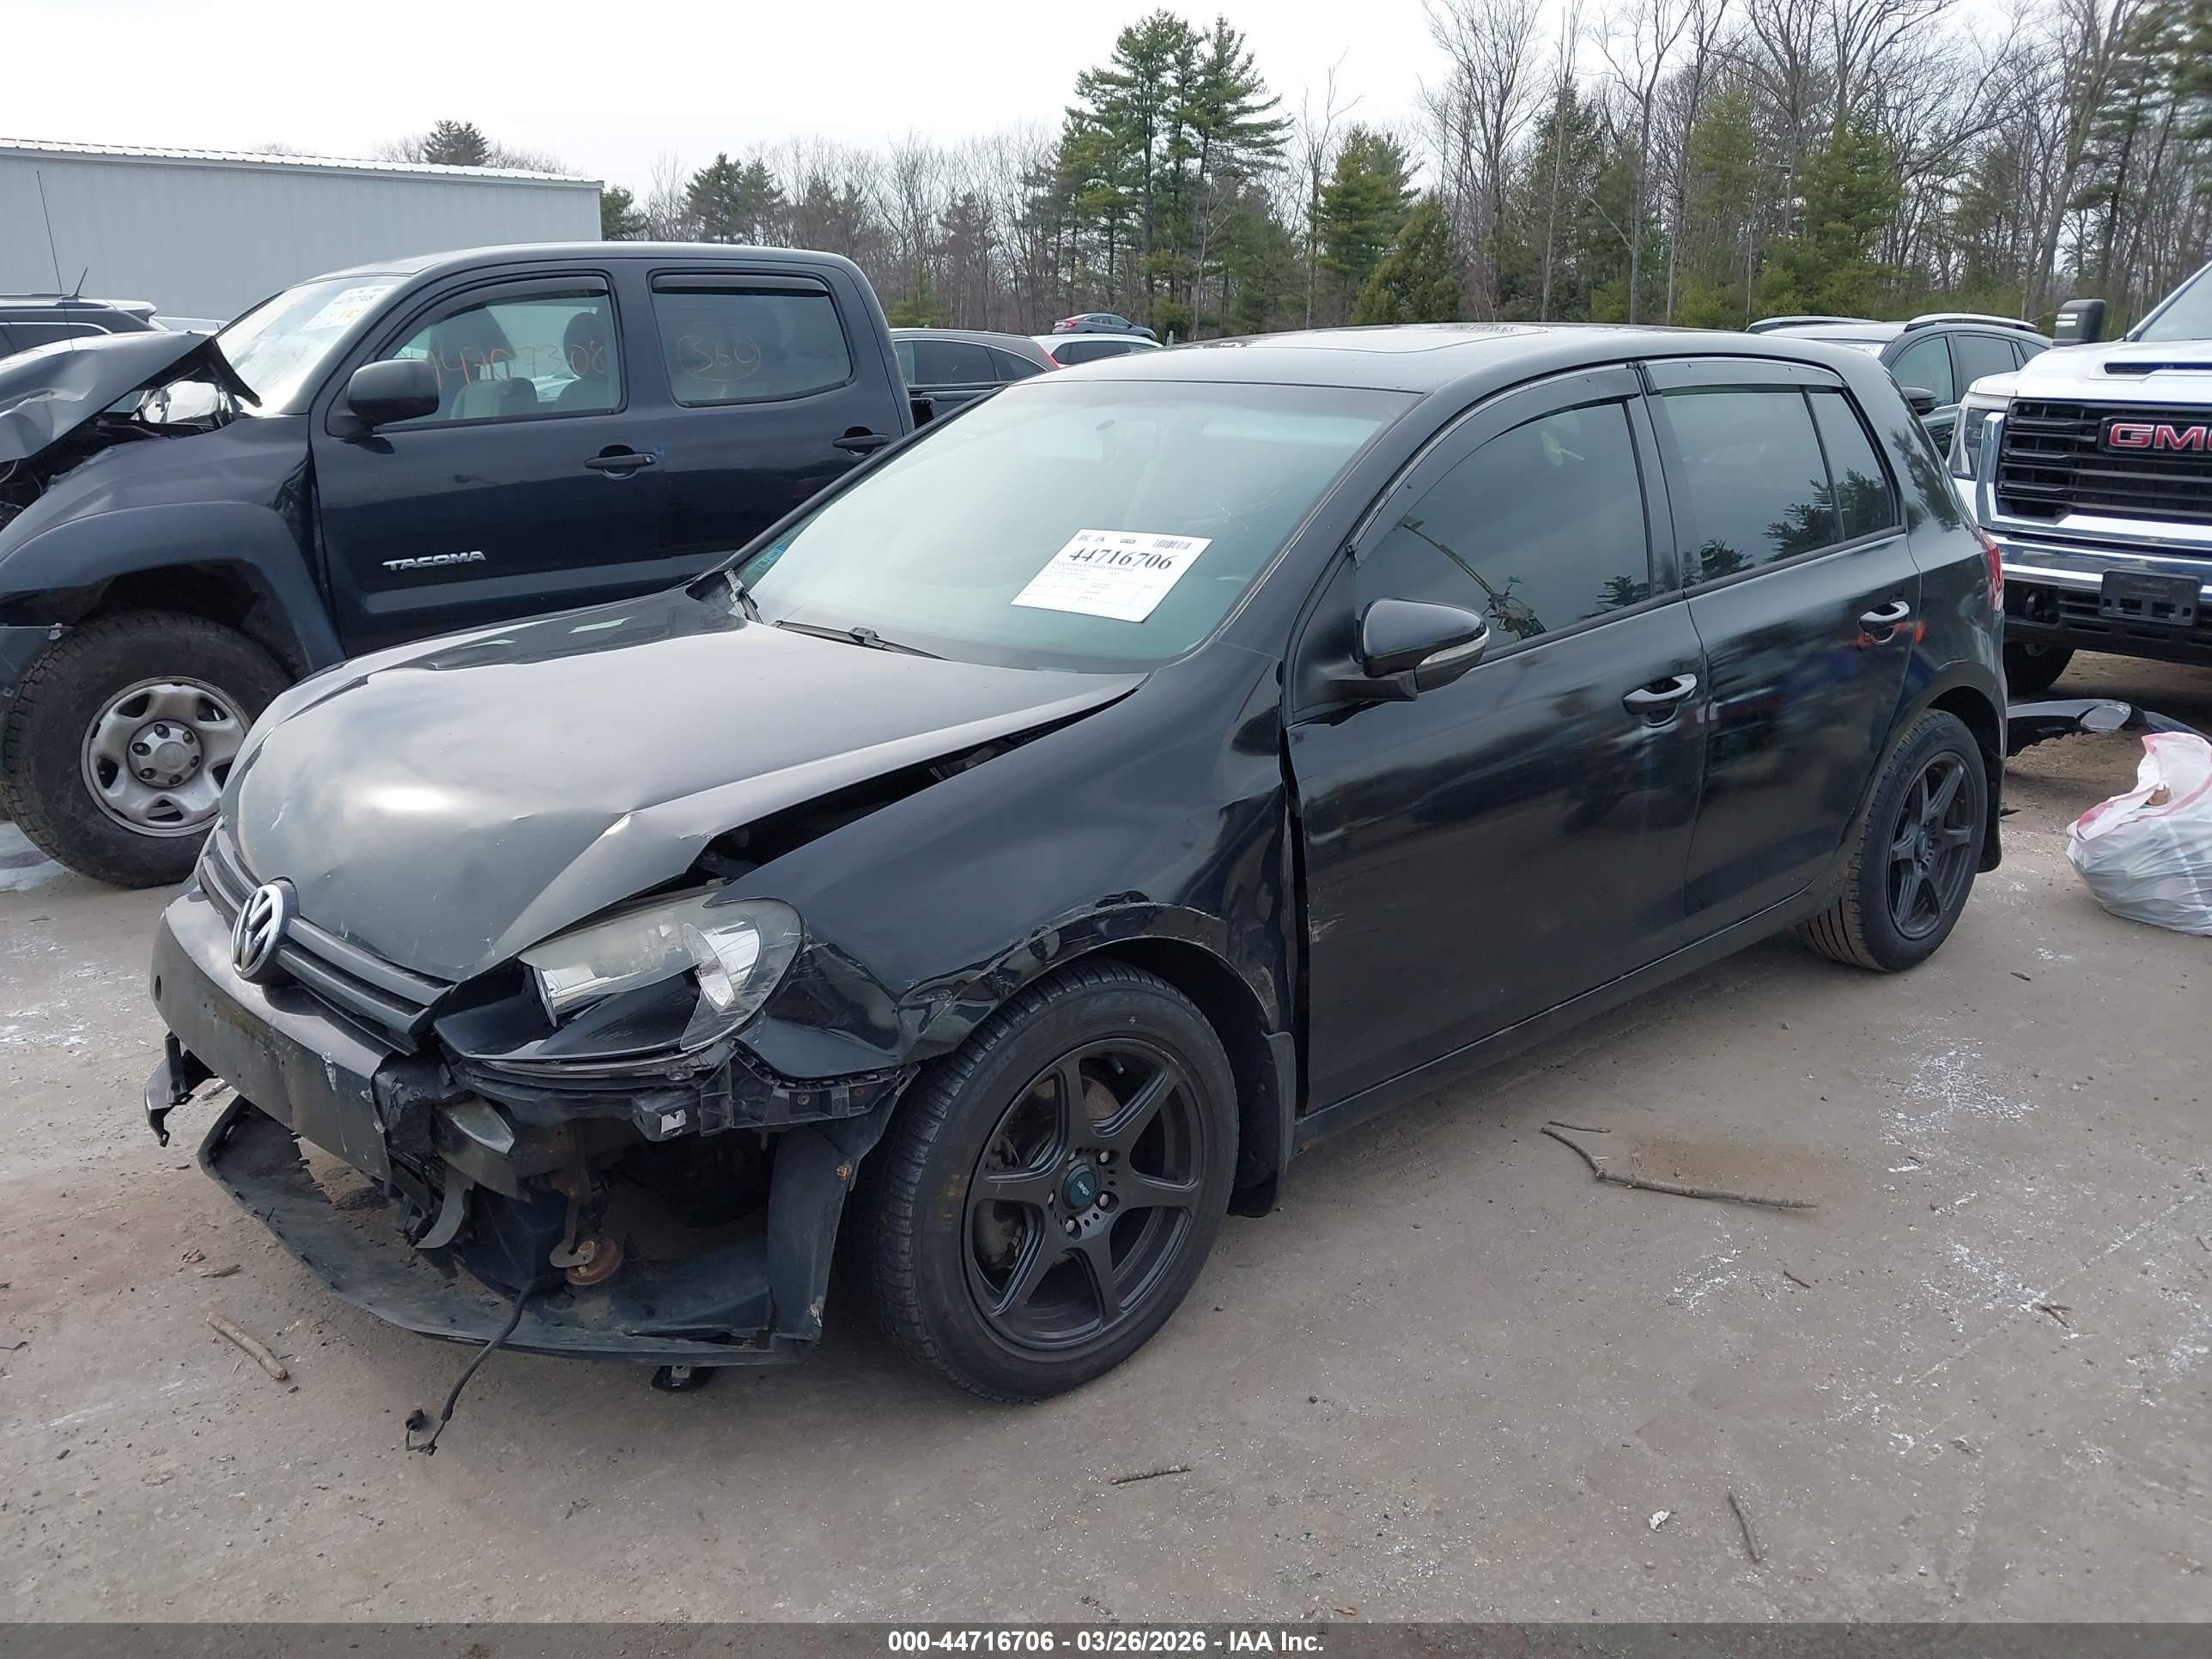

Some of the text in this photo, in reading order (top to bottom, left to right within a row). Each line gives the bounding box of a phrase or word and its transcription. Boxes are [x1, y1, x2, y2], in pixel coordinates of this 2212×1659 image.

[2109, 422, 2212, 452] GM
[381, 550, 487, 571] TACOMA
[1069, 548, 1180, 569] 44716706
